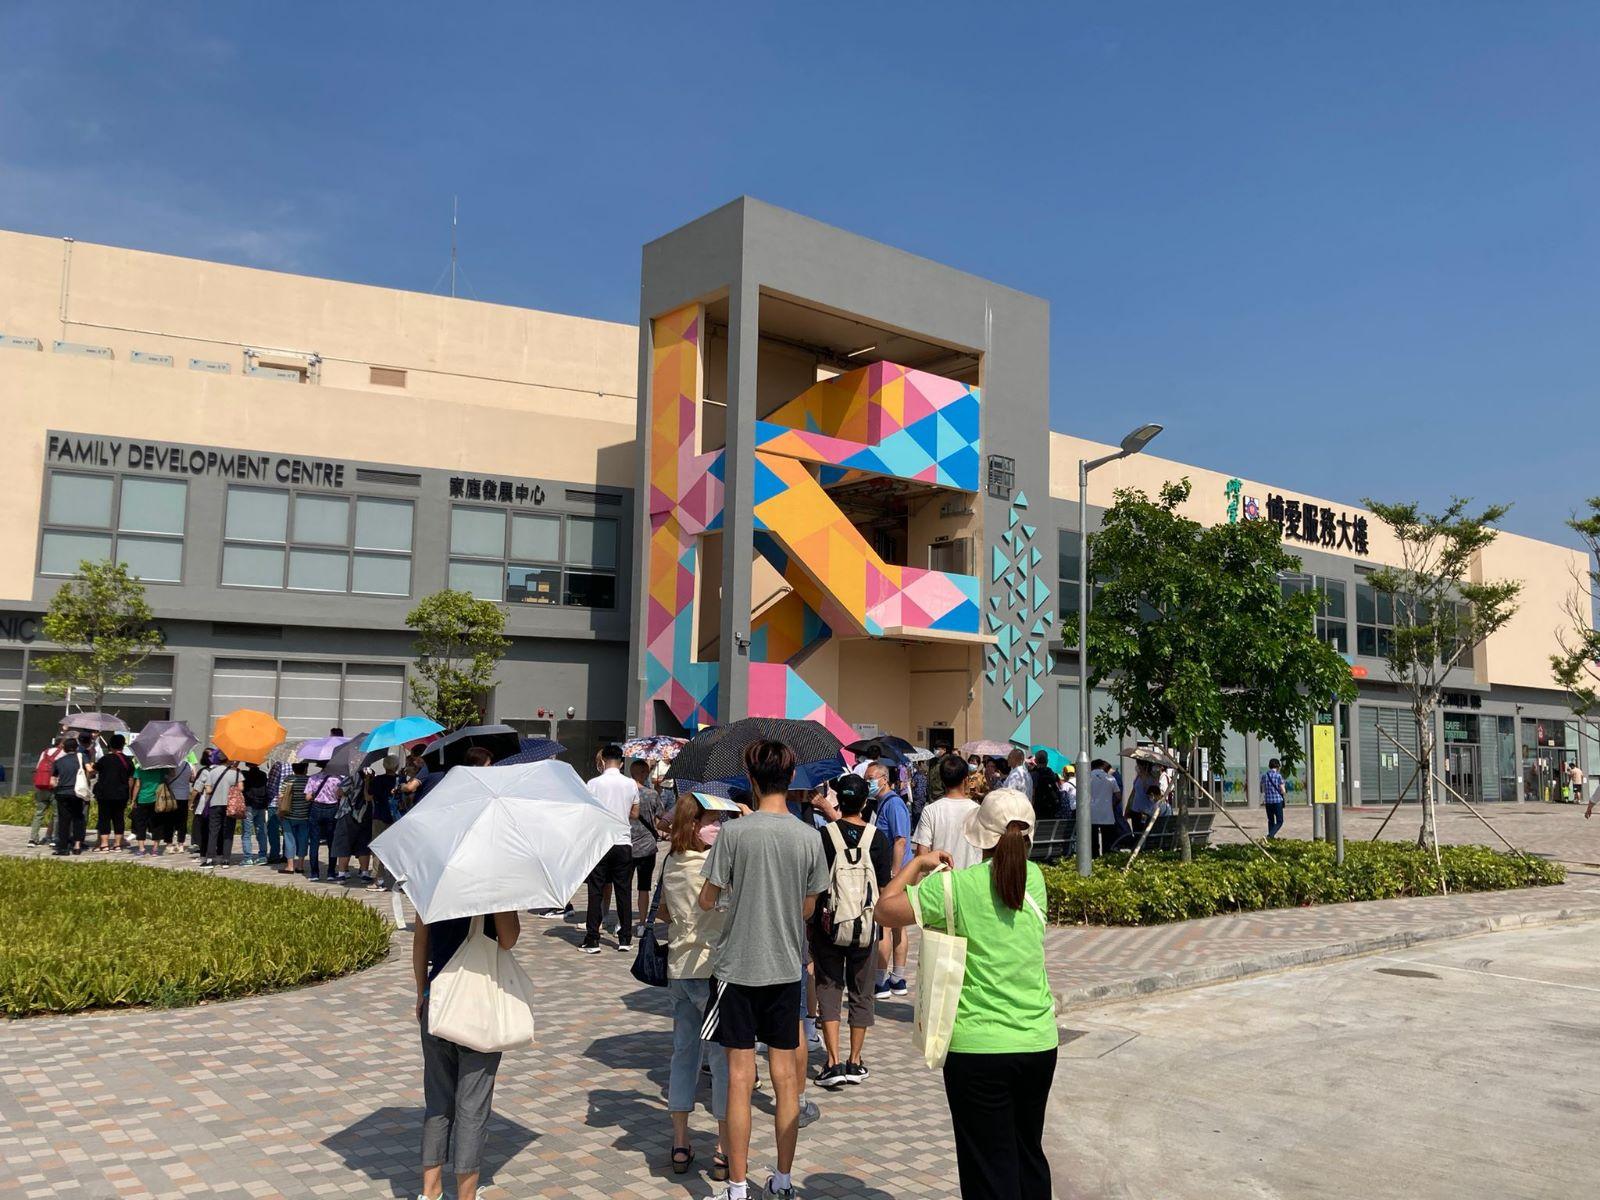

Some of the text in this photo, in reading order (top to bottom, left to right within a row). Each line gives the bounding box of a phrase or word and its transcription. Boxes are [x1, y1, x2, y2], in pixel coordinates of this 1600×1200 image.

[49, 436, 344, 488] FAMILY DEVELOPMENT CENTRE
[449, 477, 545, 505] 家庭發展中心
[1266, 492, 1369, 555] 博愛服務大樓
